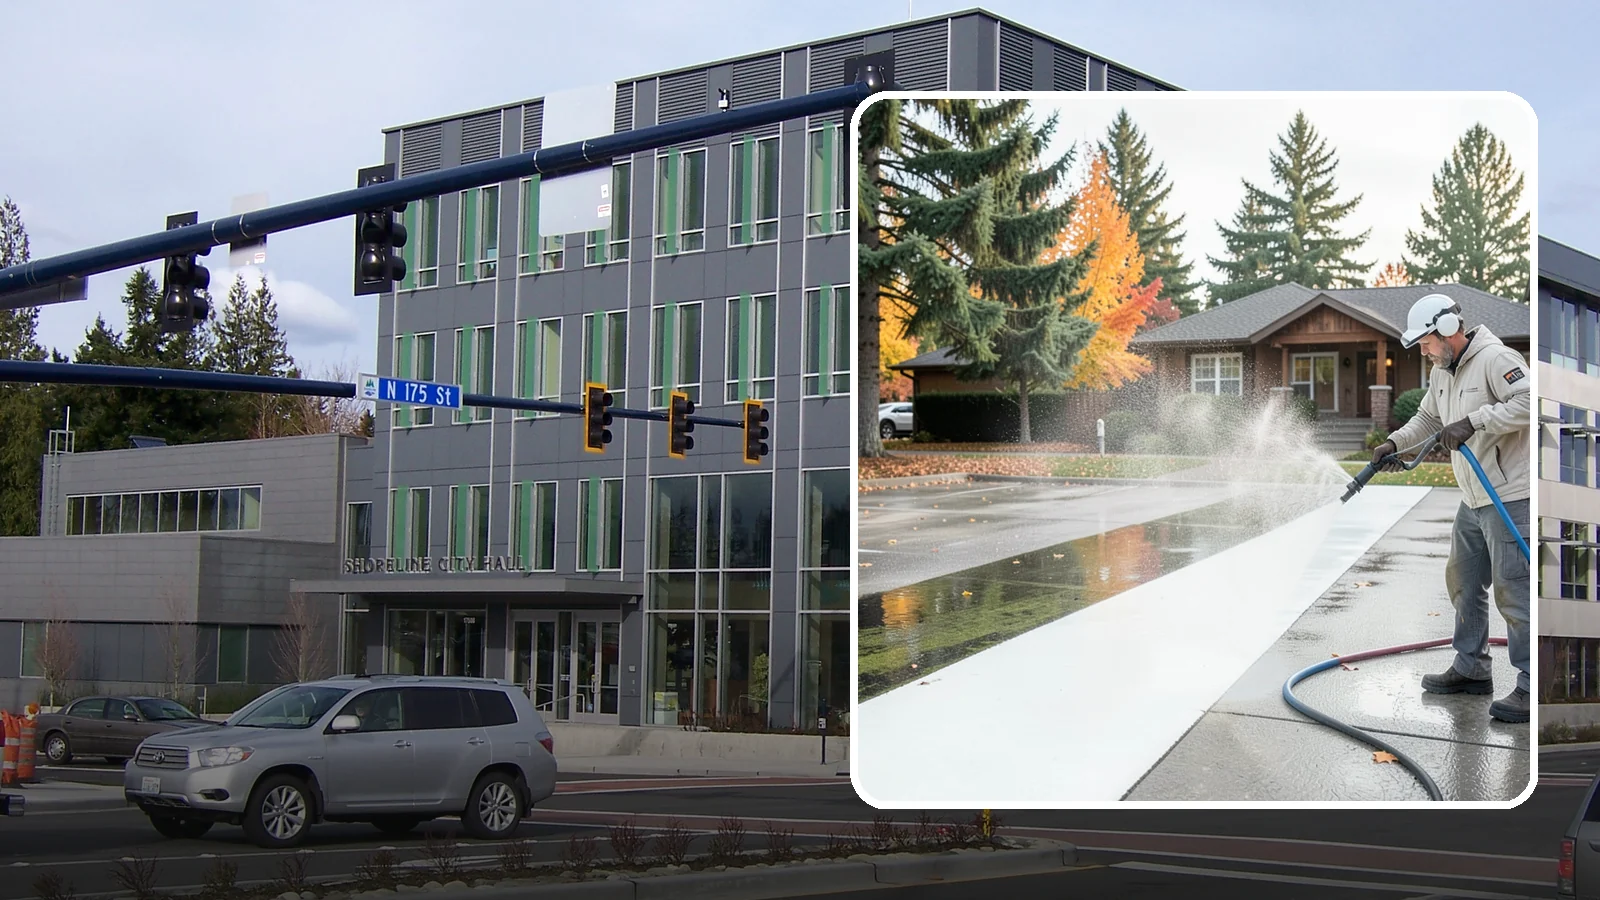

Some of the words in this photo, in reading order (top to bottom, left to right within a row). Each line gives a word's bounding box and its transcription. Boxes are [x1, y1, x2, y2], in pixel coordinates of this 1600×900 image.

[387, 380, 396, 399] N
[405, 383, 427, 403] 175
[436, 386, 451, 406] St
[344, 557, 432, 574] SHORELINE
[438, 556, 476, 572] CITY
[483, 556, 525, 572] HALL
